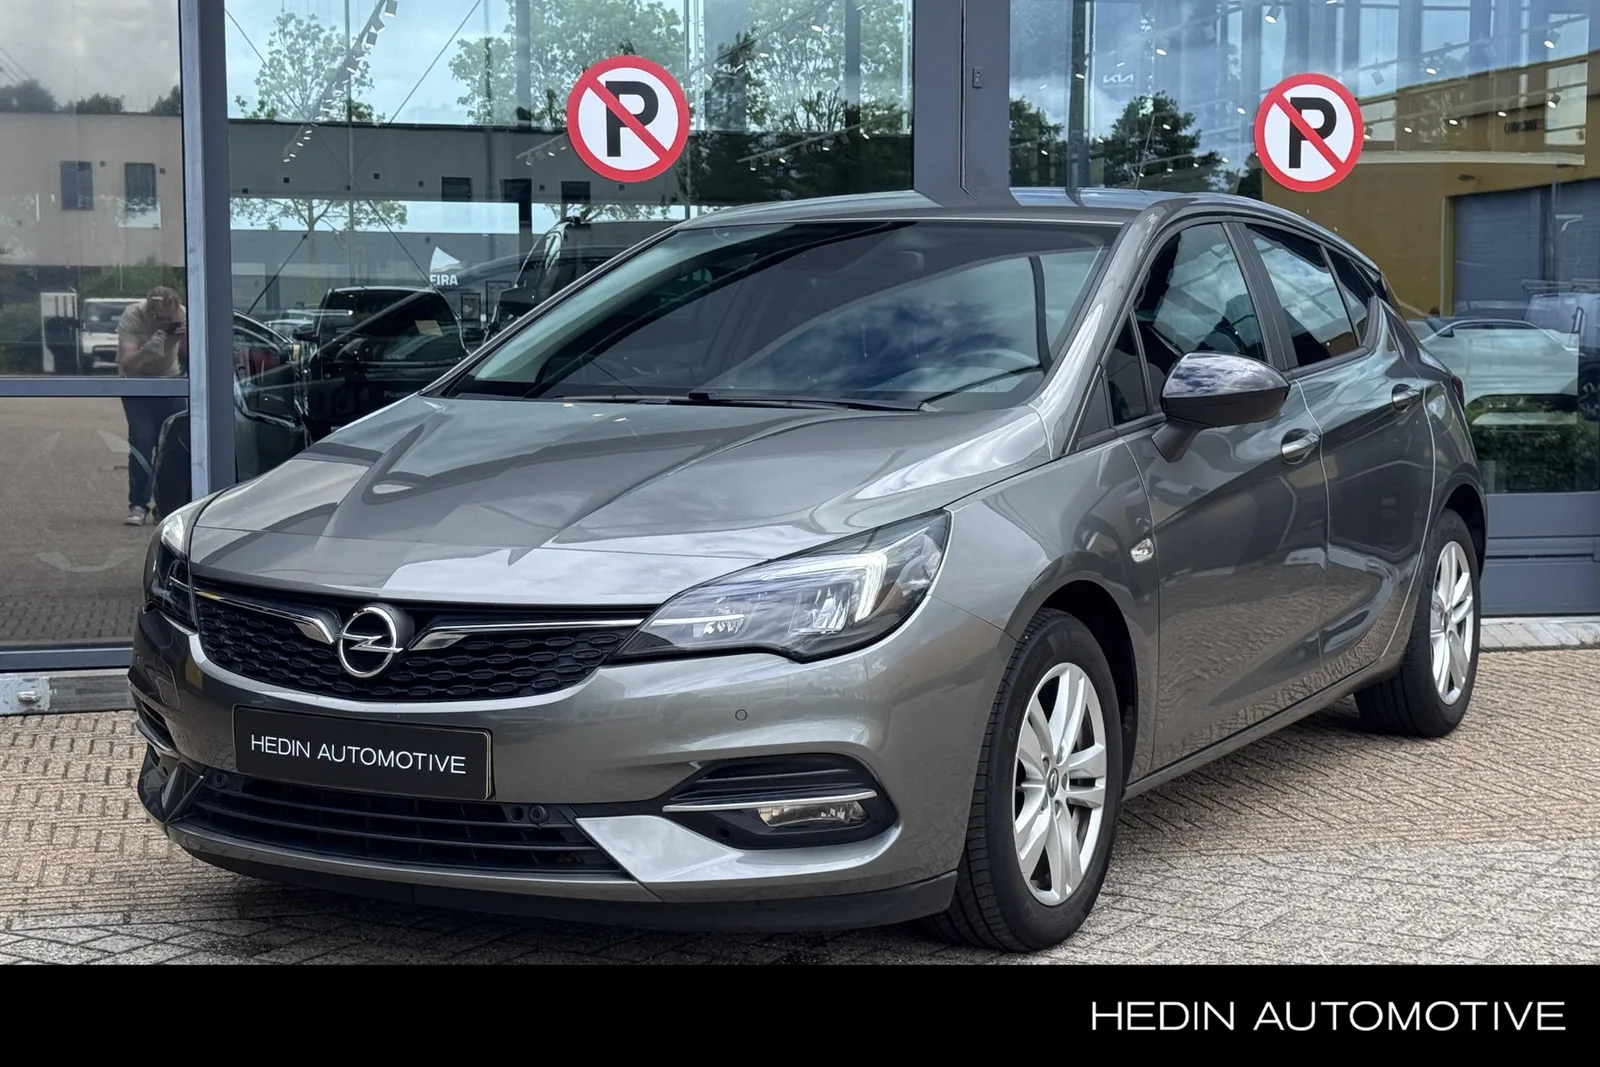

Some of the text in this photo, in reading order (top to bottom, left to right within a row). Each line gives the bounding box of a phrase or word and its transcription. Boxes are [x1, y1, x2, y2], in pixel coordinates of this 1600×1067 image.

[604, 81, 659, 157] P
[1289, 97, 1337, 168] P
[251, 734, 467, 775] HEDIN AUTOMOTIVE
